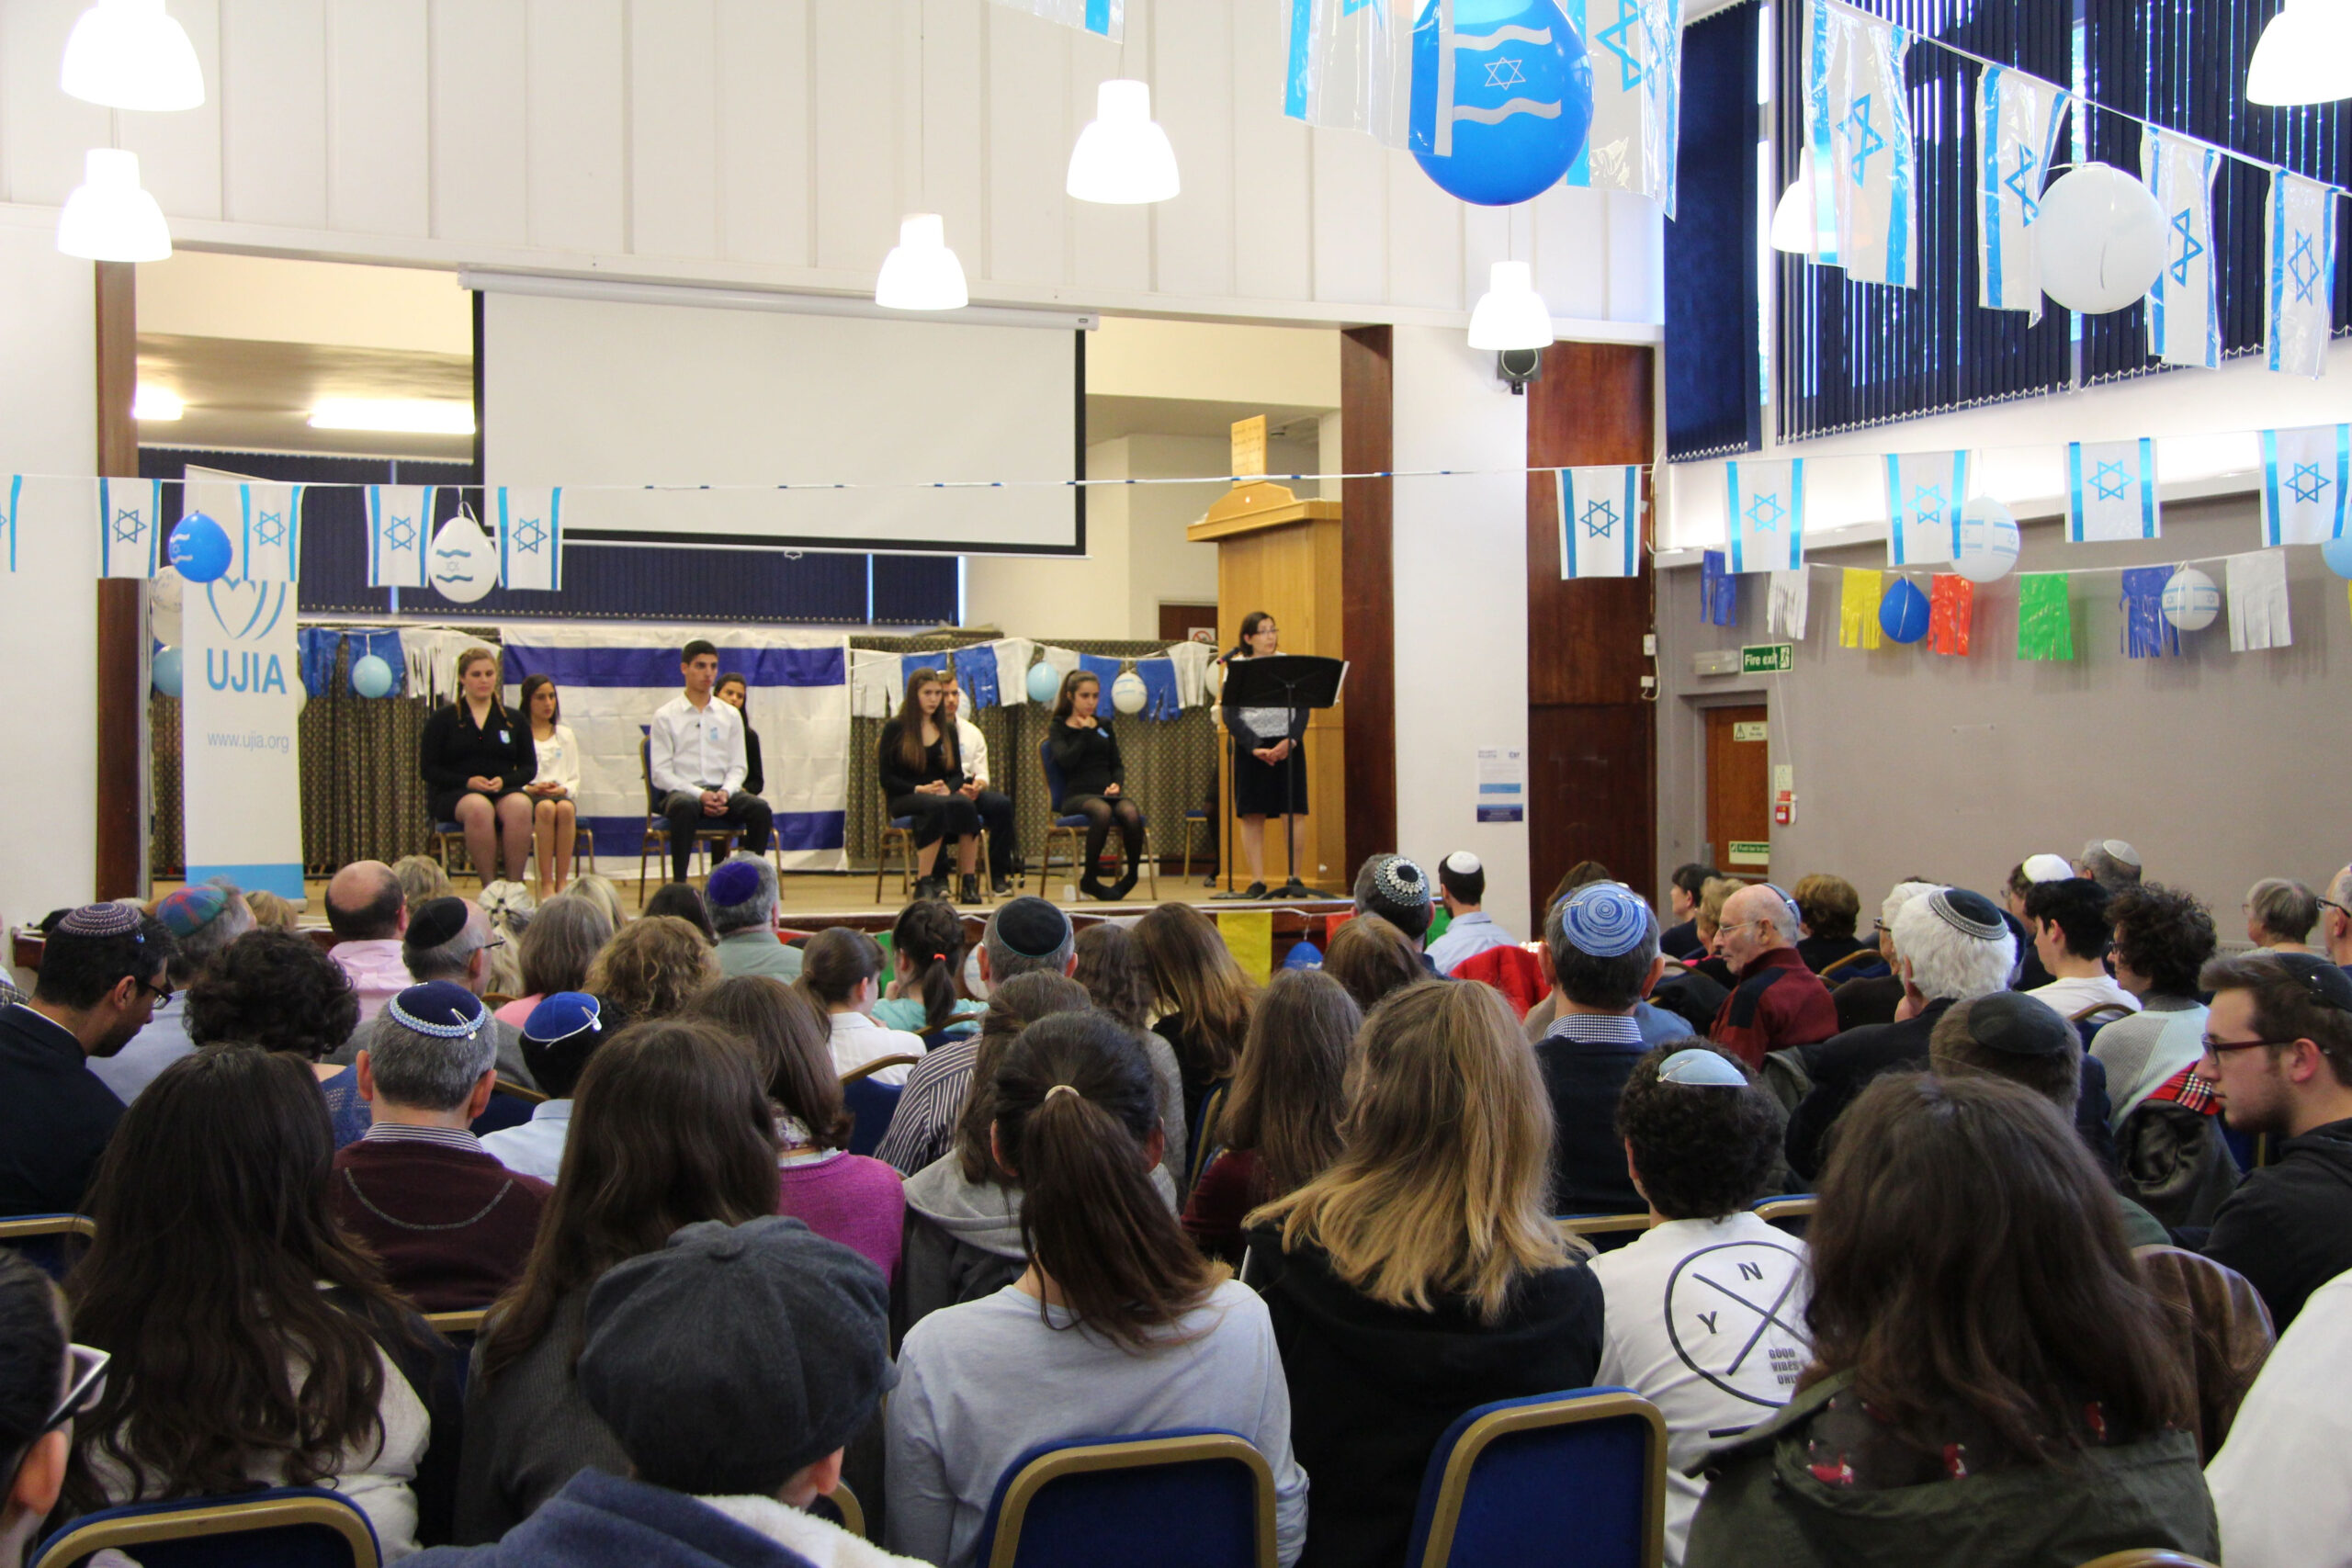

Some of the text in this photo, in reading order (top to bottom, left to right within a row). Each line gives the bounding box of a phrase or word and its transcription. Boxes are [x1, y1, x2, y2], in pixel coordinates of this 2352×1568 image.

[1745, 654, 1761, 666] Fire
[207, 648, 287, 694] UJIA
[207, 730, 289, 754] www.ujia.org
[1736, 1261, 1764, 1281] N
[1696, 1310, 1718, 1335] Y
[1769, 1348, 1795, 1359] GOOD
[1770, 1360, 1800, 1372] VIBES
[1777, 1373, 1798, 1385] ONL
